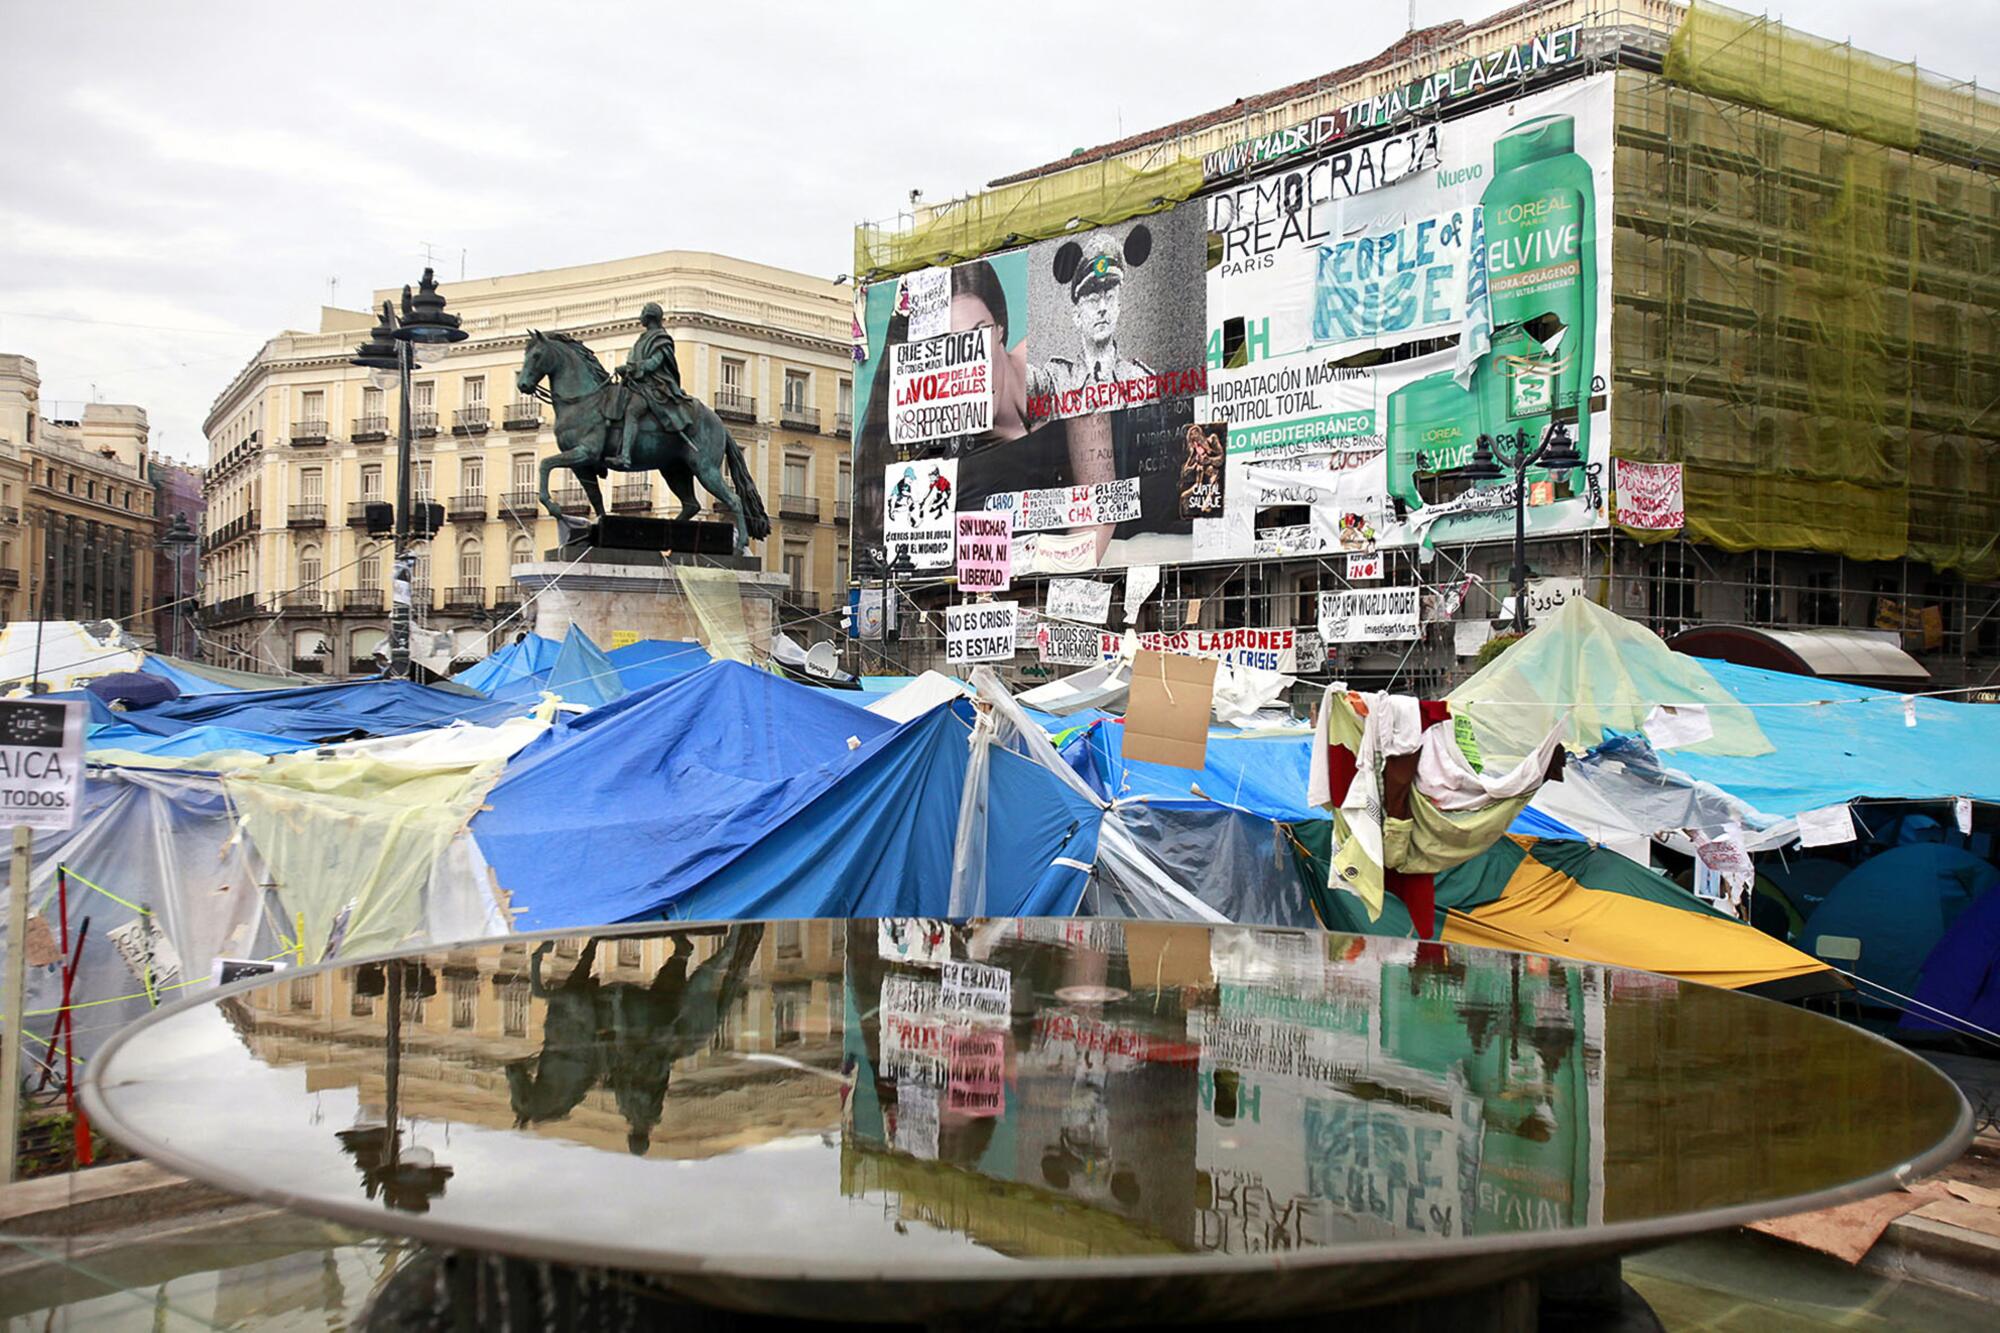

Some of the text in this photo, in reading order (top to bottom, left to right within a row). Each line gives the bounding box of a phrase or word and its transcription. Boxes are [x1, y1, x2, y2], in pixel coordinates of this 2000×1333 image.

[1203, 23, 1582, 177] WWW.MADRID.TOMALAPLAZA.NET
[1437, 163, 1482, 189] Nuevo
[1227, 207, 1330, 261] REAL
[1318, 212, 1463, 283] PEOPLE of
[1488, 223, 1580, 273] ELVIVE
[1313, 265, 1453, 340] RISE
[898, 330, 986, 367] QUE SE OIGA
[1248, 317, 1269, 362] H
[951, 365, 986, 381] DE LAS
[897, 372, 950, 406] LA VOZ
[1027, 365, 1208, 420] NO NOS REPRESENTAN
[1211, 366, 1301, 404] HIDRATACIÓN
[897, 410, 915, 424] NO
[1211, 400, 1273, 423] CONTROL
[1276, 390, 1323, 416] TOTAL.
[895, 401, 987, 441] NOS REPRESENTAN!
[1250, 415, 1369, 447] MEDITERRÁNEO
[985, 494, 1014, 511] CLARO
[1028, 516, 1064, 529] SISTEMA
[1068, 507, 1093, 523] CHA
[960, 519, 1008, 540] SIN LUCHAR,
[918, 542, 948, 554] MUNDO?
[960, 544, 970, 561] NI
[972, 544, 994, 564] PAN,
[995, 544, 1007, 561] NI
[960, 569, 1005, 586] LIBERTAD.
[1322, 591, 1416, 618] STOP NEW WORLD ORDER
[948, 609, 1013, 633] NO ES CRISIS:
[948, 635, 1012, 658] ES ESTAFA!
[1050, 627, 1077, 642] TODOS
[1079, 628, 1098, 643] SOIS
[1197, 629, 1293, 650] LADRONES
[1047, 642, 1057, 656] EL
[1058, 641, 1098, 657] ENEMIGO
[1239, 650, 1278, 670] CRISIS
[17, 720, 37, 729] UE
[2, 789, 70, 808] TODOS.
